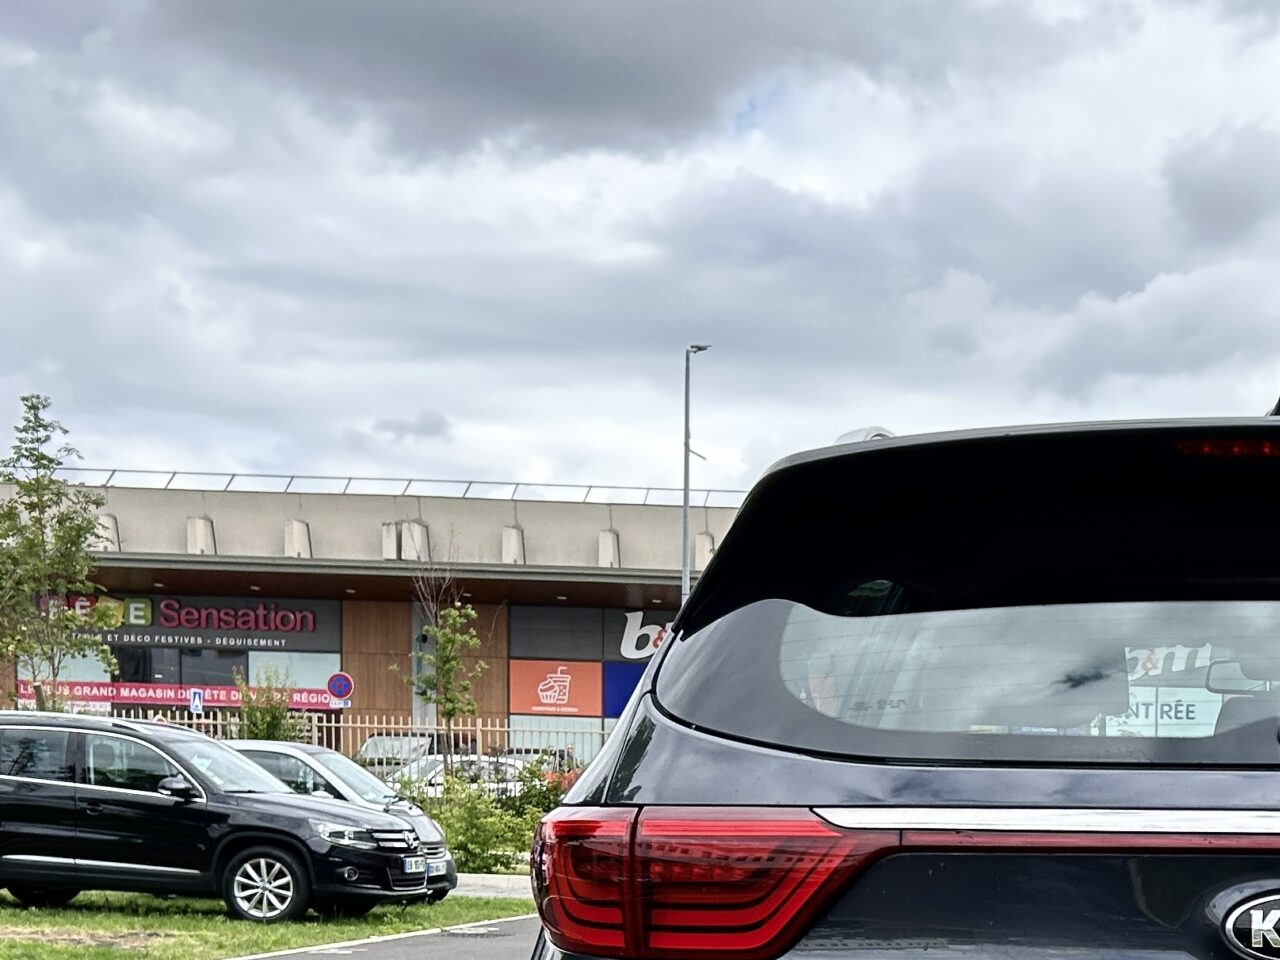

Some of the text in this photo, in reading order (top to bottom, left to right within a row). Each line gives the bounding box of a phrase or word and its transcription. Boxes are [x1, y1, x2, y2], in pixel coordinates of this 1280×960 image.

[159, 599, 315, 632] Sensation
[154, 635, 203, 645] FESTIVES
[73, 686, 116, 697] GRAND
[120, 687, 175, 699] MAGASIN
[292, 691, 331, 704] RÉGIO
[1129, 699, 1197, 720] NTRÉE
